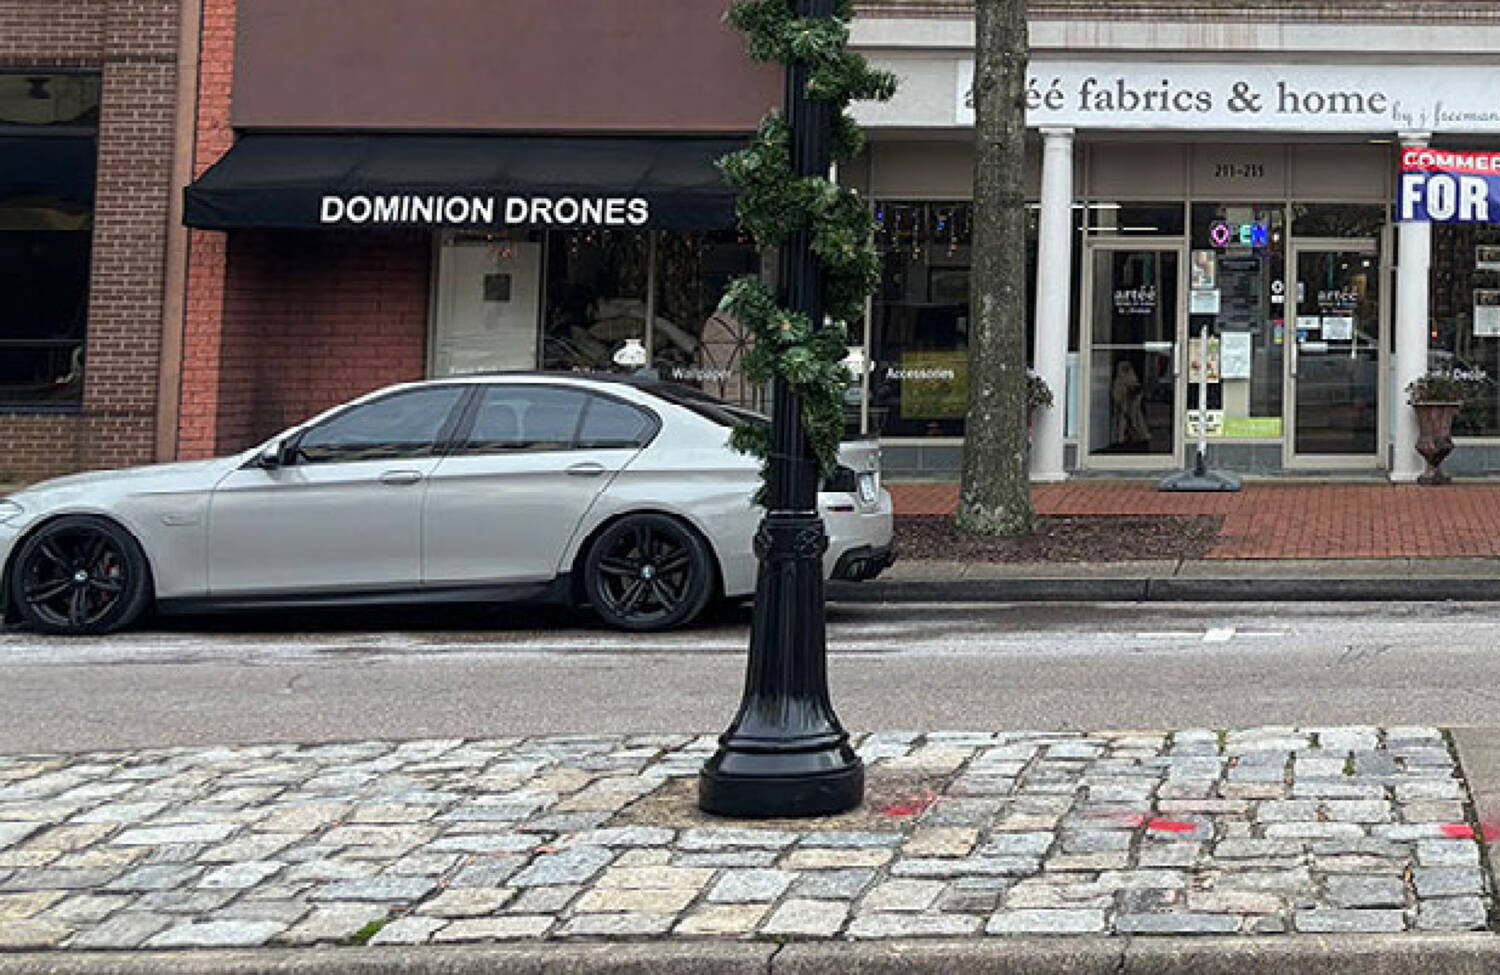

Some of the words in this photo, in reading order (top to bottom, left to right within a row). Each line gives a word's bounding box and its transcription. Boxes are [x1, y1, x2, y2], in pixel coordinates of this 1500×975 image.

[964, 78, 1064, 110] aéé
[1078, 77, 1212, 113] fabrics
[1227, 81, 1265, 114] &
[1277, 82, 1387, 116] home
[320, 195, 494, 224] DOMINION
[505, 198, 649, 225] DRONES
[1401, 174, 1489, 221] FOR
